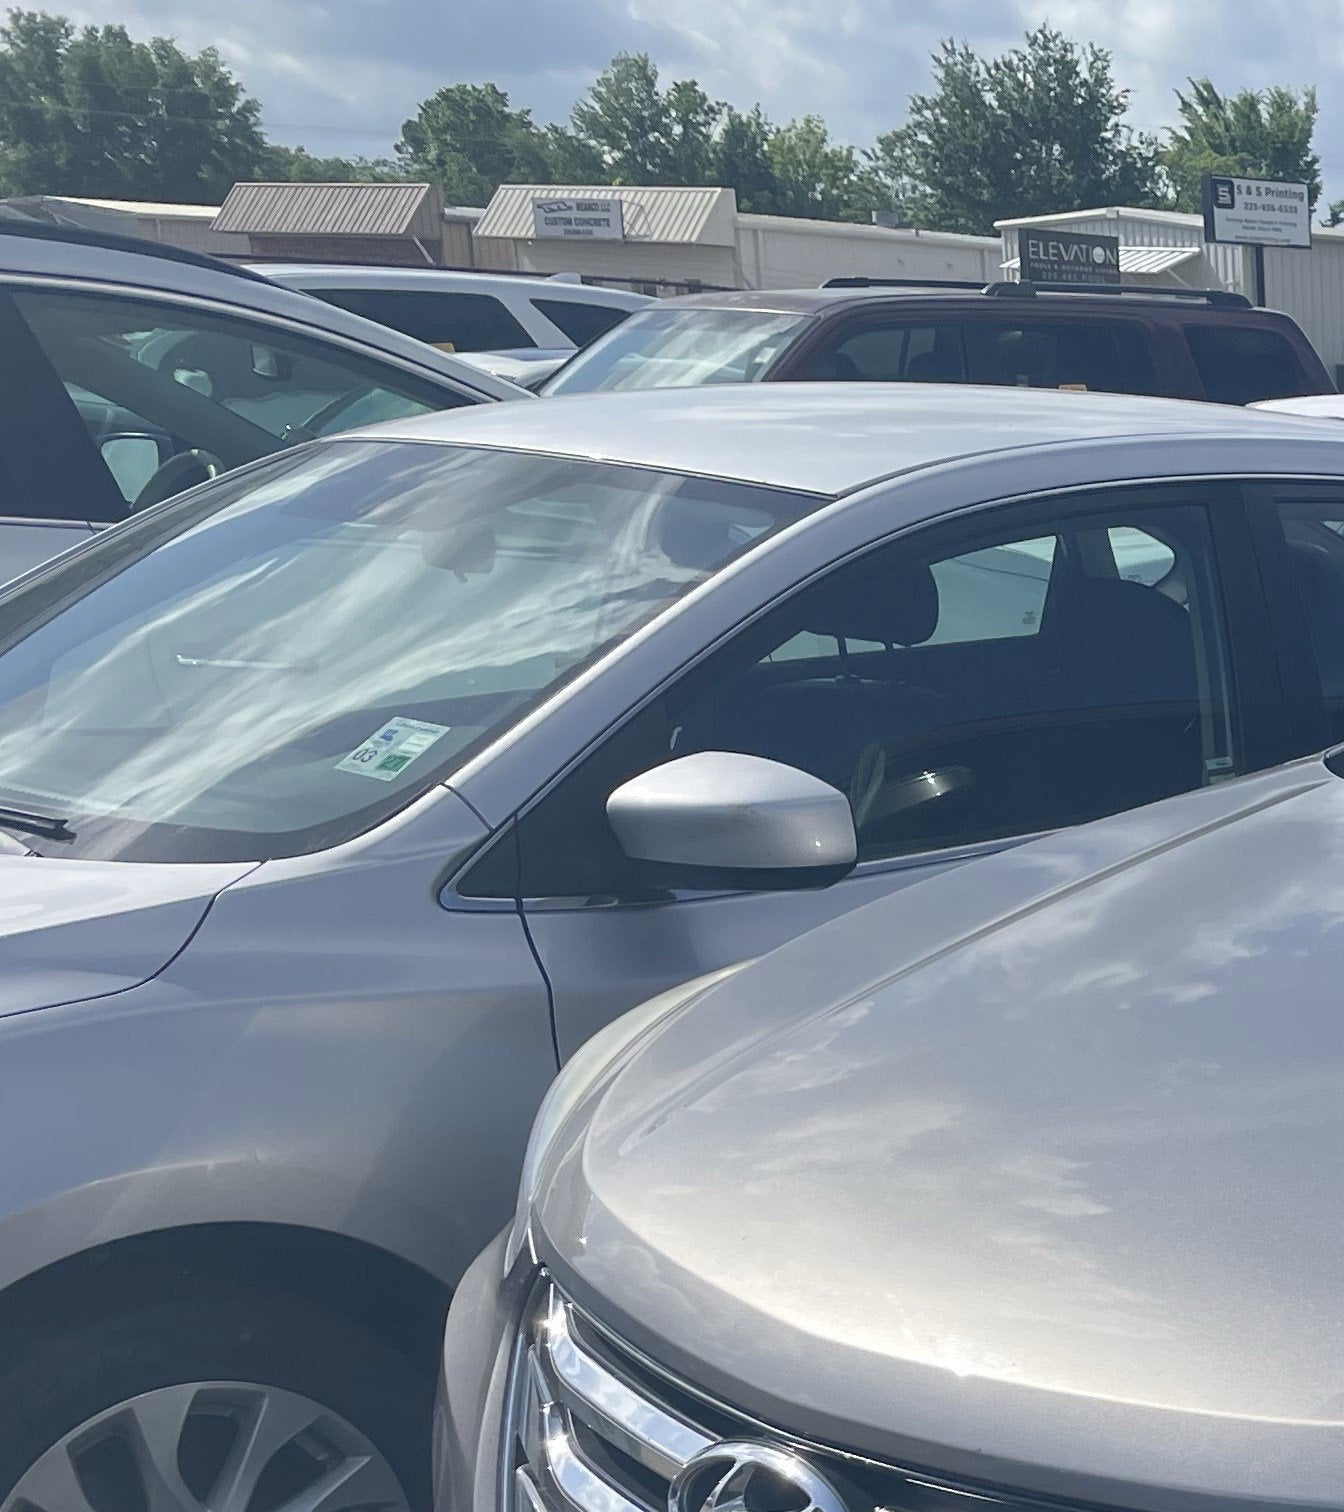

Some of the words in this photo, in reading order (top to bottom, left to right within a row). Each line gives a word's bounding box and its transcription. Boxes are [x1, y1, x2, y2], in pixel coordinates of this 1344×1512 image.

[1236, 184, 1243, 195] S
[1245, 185, 1252, 196] &
[1255, 186, 1262, 197] S
[1265, 187, 1305, 202] Printing
[544, 216, 573, 226] CUSTOM
[573, 216, 611, 227] CONCRETE
[1028, 239, 1118, 266] ELEVATION
